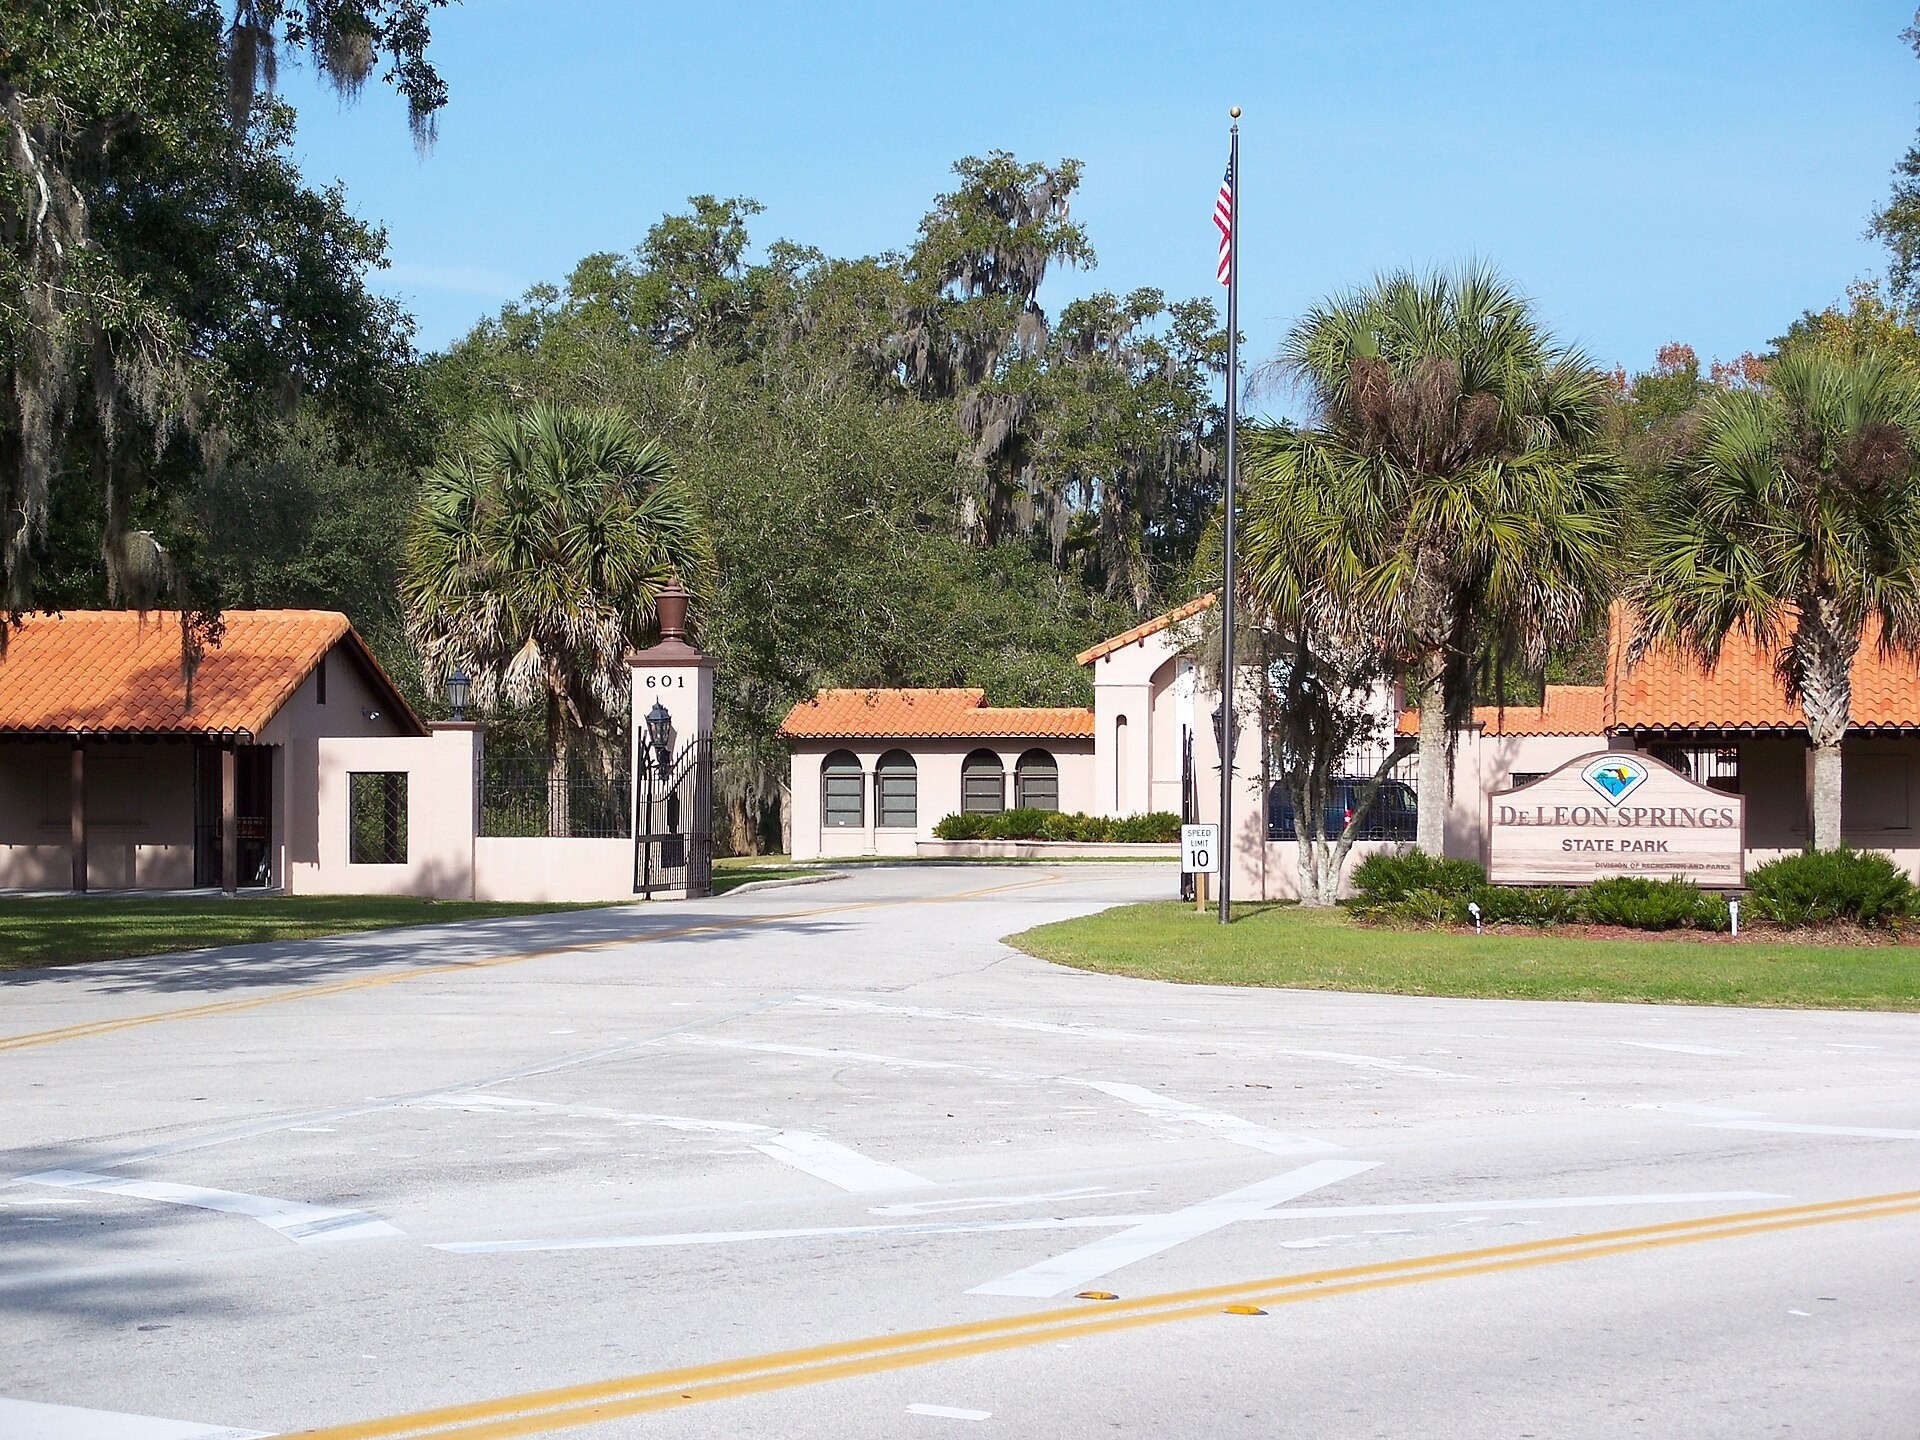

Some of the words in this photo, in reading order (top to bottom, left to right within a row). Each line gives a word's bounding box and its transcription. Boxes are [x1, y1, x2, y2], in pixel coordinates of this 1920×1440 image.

[646, 675, 684, 688] 601
[1617, 807, 1734, 828] SPRINGS
[1190, 839, 1209, 847] LIMIT
[1562, 839, 1614, 852] STATE
[1620, 840, 1668, 852] PARK
[1190, 850, 1208, 867] 10
[1642, 862, 1686, 870] RECREATION
